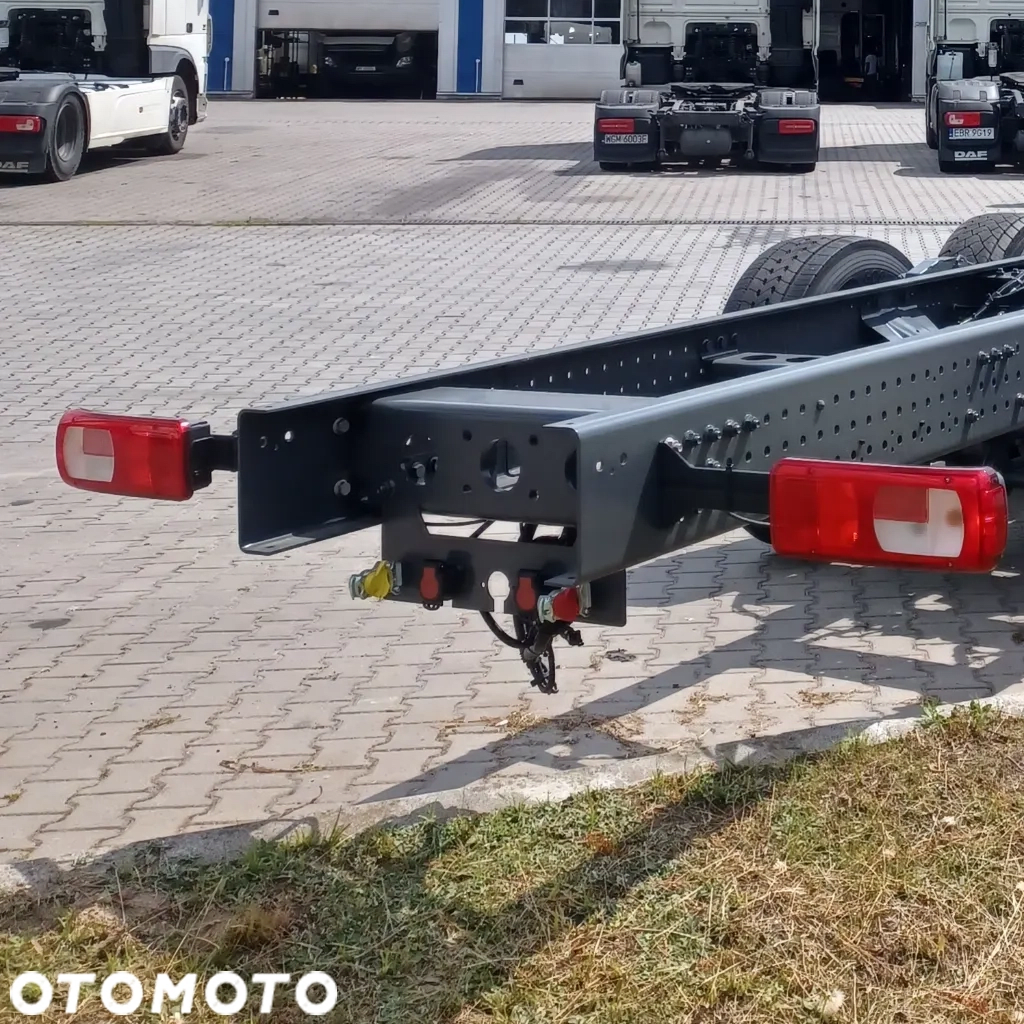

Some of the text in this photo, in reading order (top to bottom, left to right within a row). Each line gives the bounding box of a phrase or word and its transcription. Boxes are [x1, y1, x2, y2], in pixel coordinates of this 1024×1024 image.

[954, 128, 992, 137] EBR 9G19
[954, 150, 988, 158] DAF
[0, 161, 29, 169] AF
